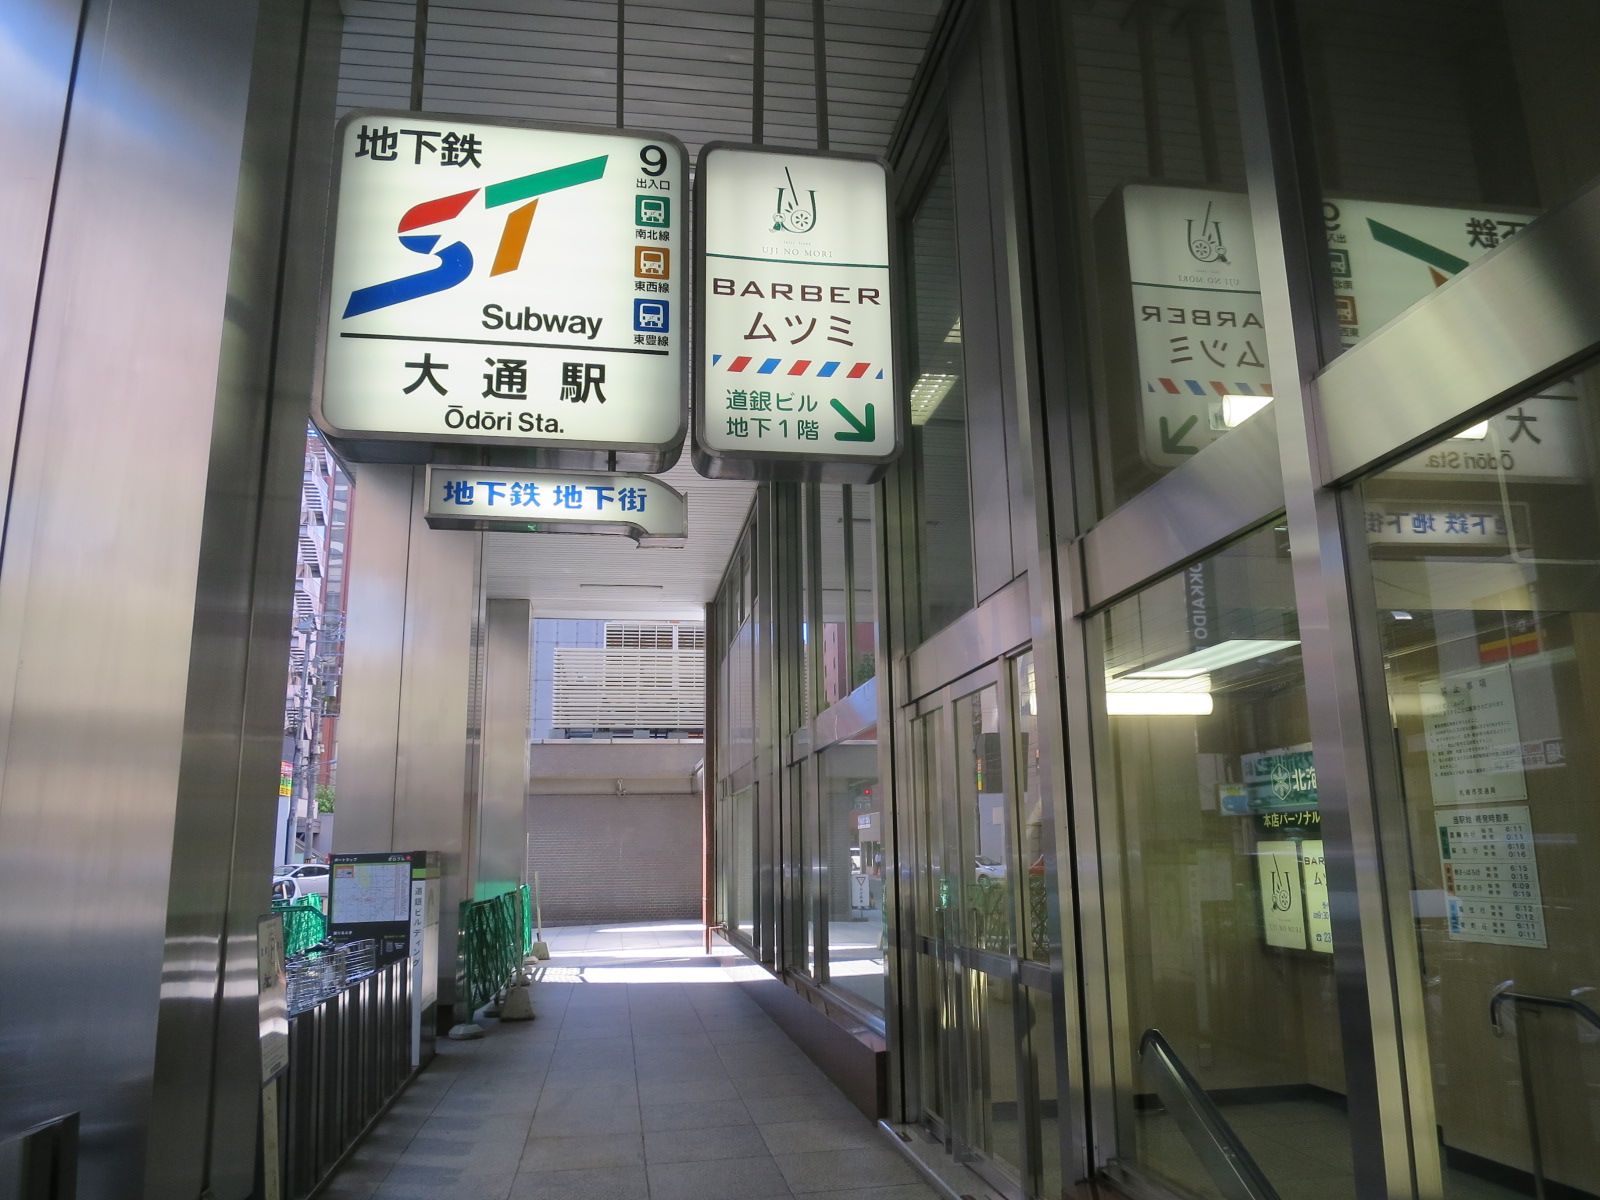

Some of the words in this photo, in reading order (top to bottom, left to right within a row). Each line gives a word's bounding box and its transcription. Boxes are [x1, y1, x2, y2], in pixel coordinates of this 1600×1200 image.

[355, 125, 482, 168] 地下鉄
[639, 145, 668, 177] 9
[636, 178, 670, 190] 出入口
[635, 229, 670, 242] 南北線
[762, 246, 779, 255] UJI
[784, 247, 800, 256] NO
[804, 249, 833, 258] MORI
[634, 281, 670, 294] 東西線
[713, 277, 881, 305] BARBER
[482, 304, 603, 340] Subway
[744, 312, 854, 347] ムツミ
[633, 334, 670, 347] 東豊線
[402, 353, 606, 404] 大通駅
[726, 388, 818, 412] 道銀ビル
[444, 405, 513, 431] Ōdōri
[518, 412, 565, 433] Sta.
[726, 416, 819, 441] 地下1階
[443, 480, 541, 508] 地下鉄
[553, 484, 648, 512] 地下街
